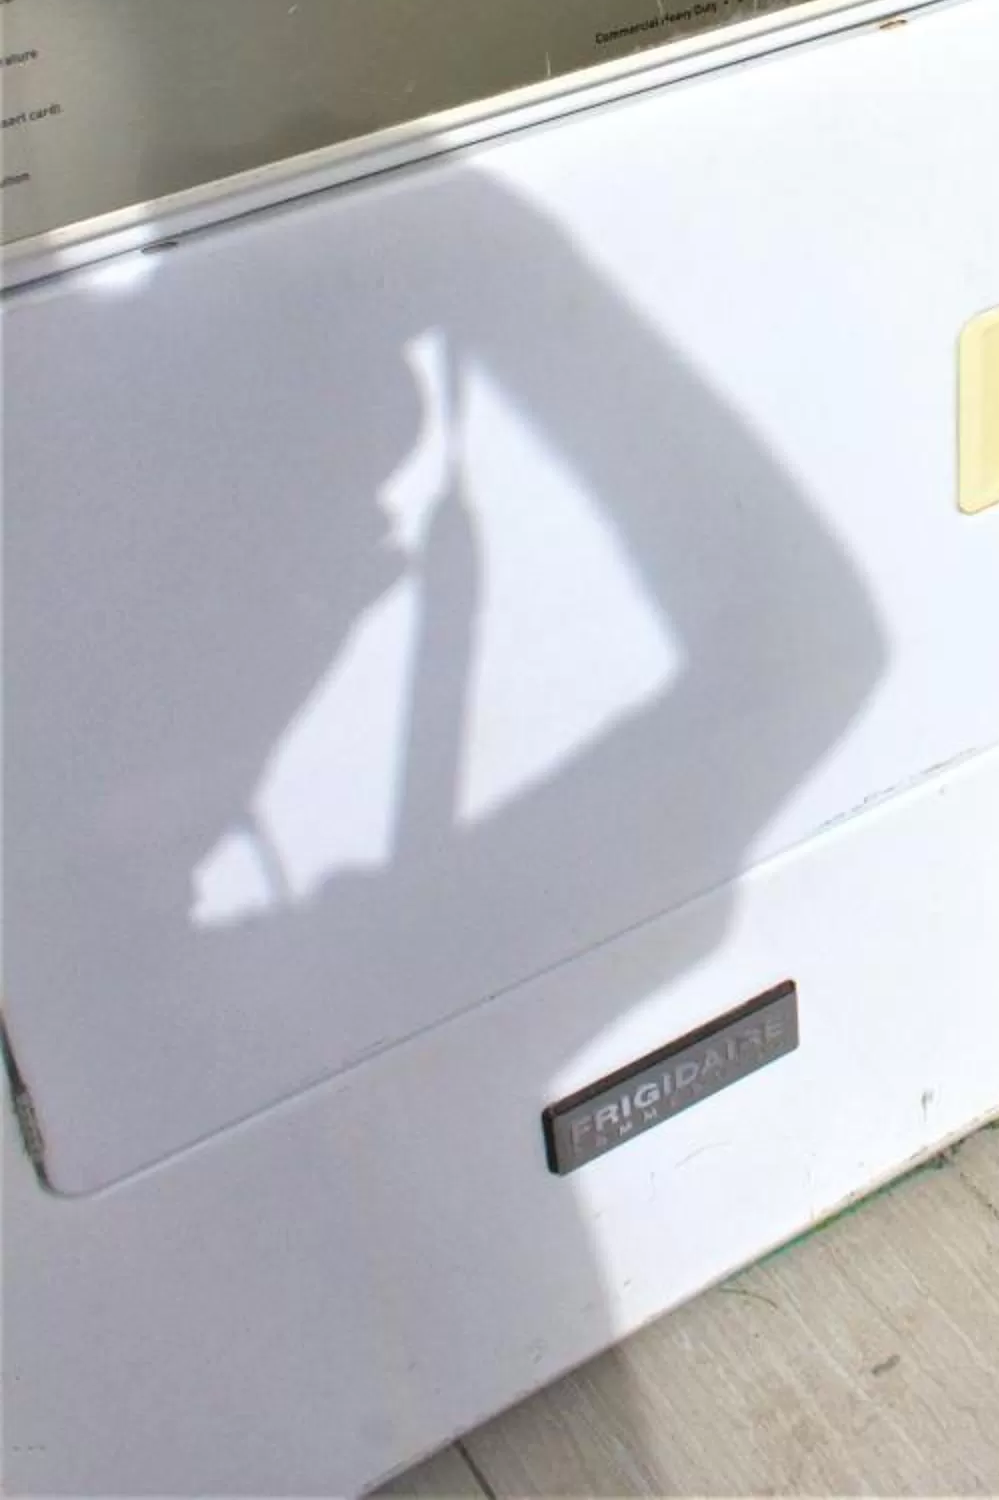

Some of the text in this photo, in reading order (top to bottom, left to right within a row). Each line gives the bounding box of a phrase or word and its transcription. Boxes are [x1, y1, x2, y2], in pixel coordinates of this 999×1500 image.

[595, 14, 659, 46] Commercial
[693, 0, 718, 16] Duty
[570, 1017, 785, 1145] FRIGIDAIRE
